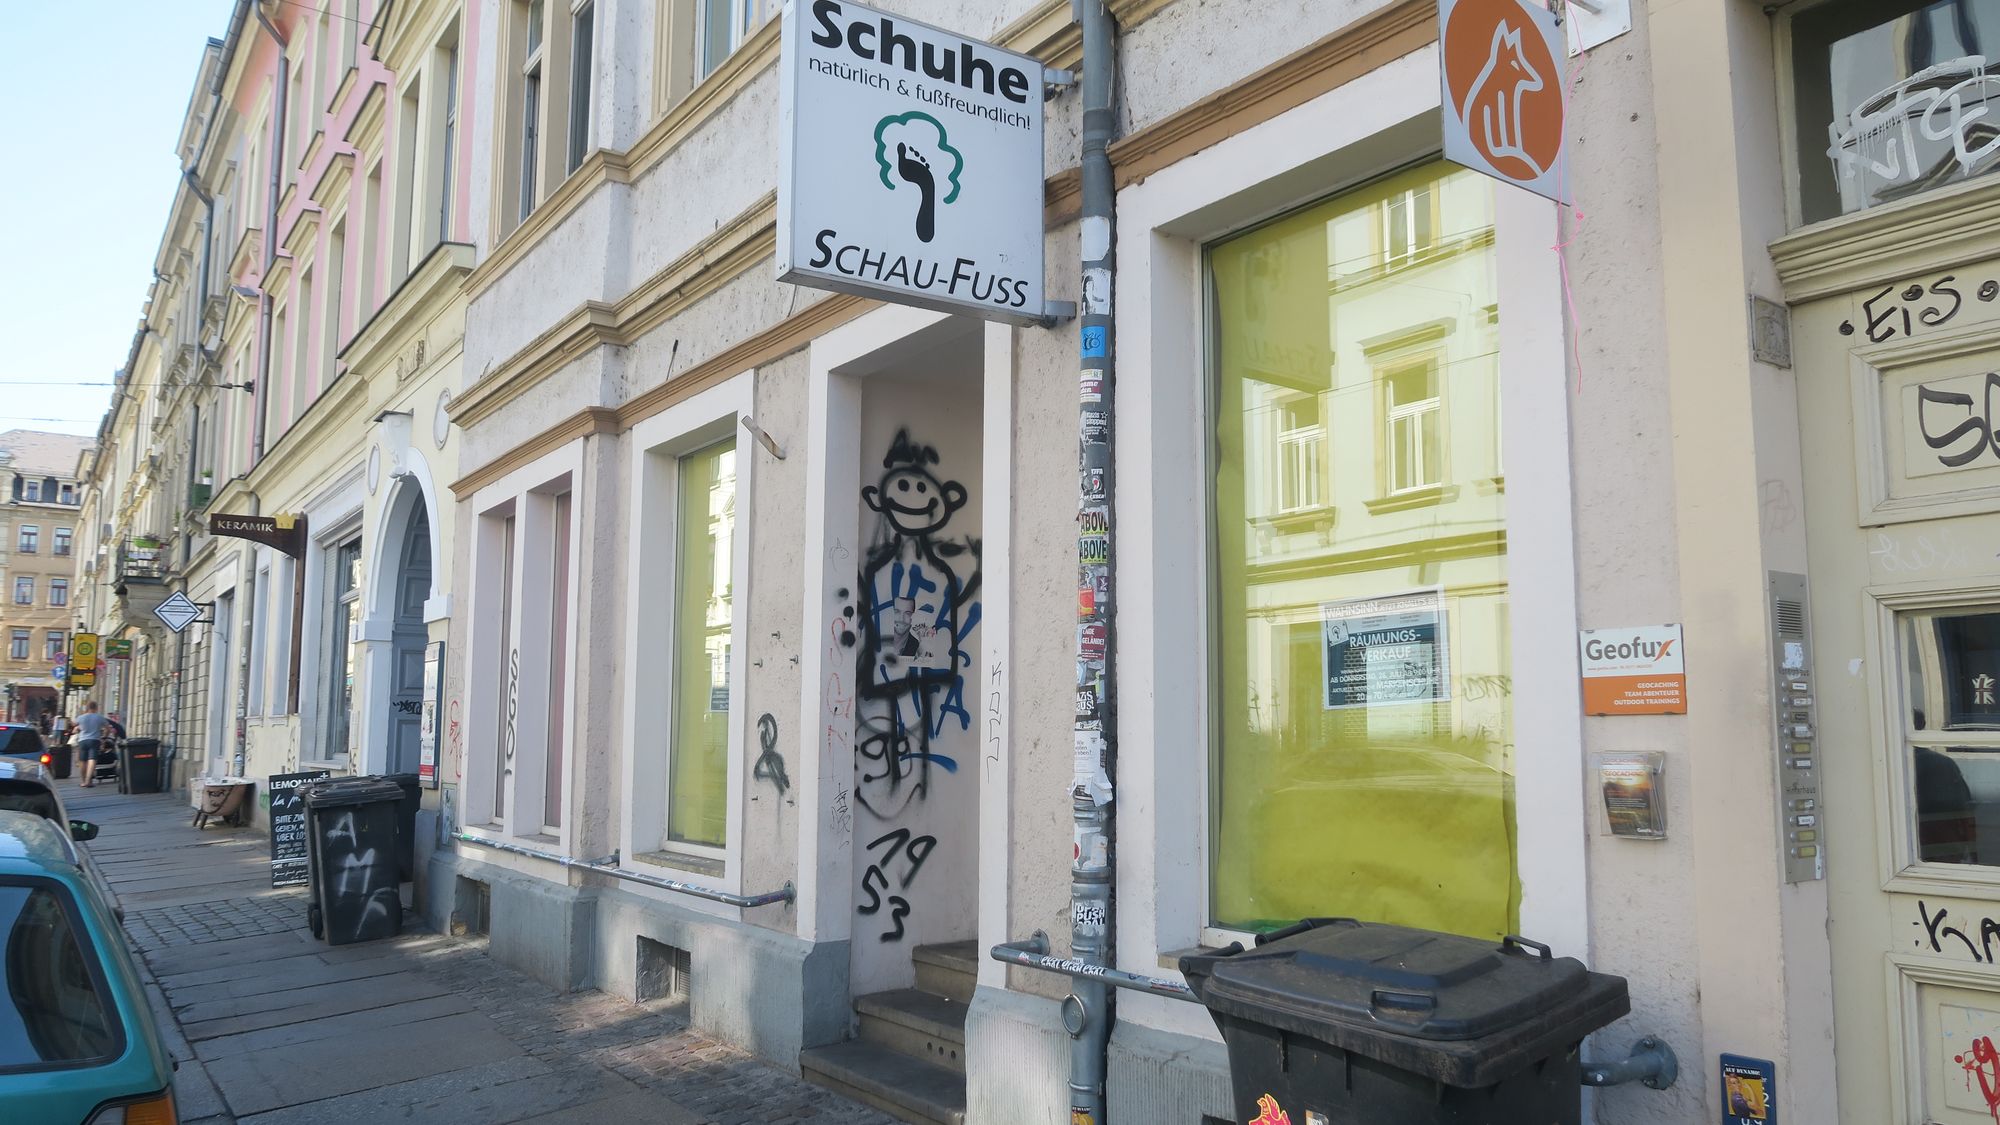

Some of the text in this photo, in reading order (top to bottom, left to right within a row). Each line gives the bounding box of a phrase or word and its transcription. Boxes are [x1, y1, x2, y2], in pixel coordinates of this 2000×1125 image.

[811, 0, 1029, 104] Schuhe
[809, 57, 1031, 130] natürlich & fußfreundlich!
[217, 520, 273, 533] KERAMIK
[1326, 602, 1378, 618] WAHNSINN
[1349, 629, 1421, 648] RÄUMUNGS-
[1360, 646, 1411, 662] VERKAUF
[1586, 636, 1676, 661] Geofux
